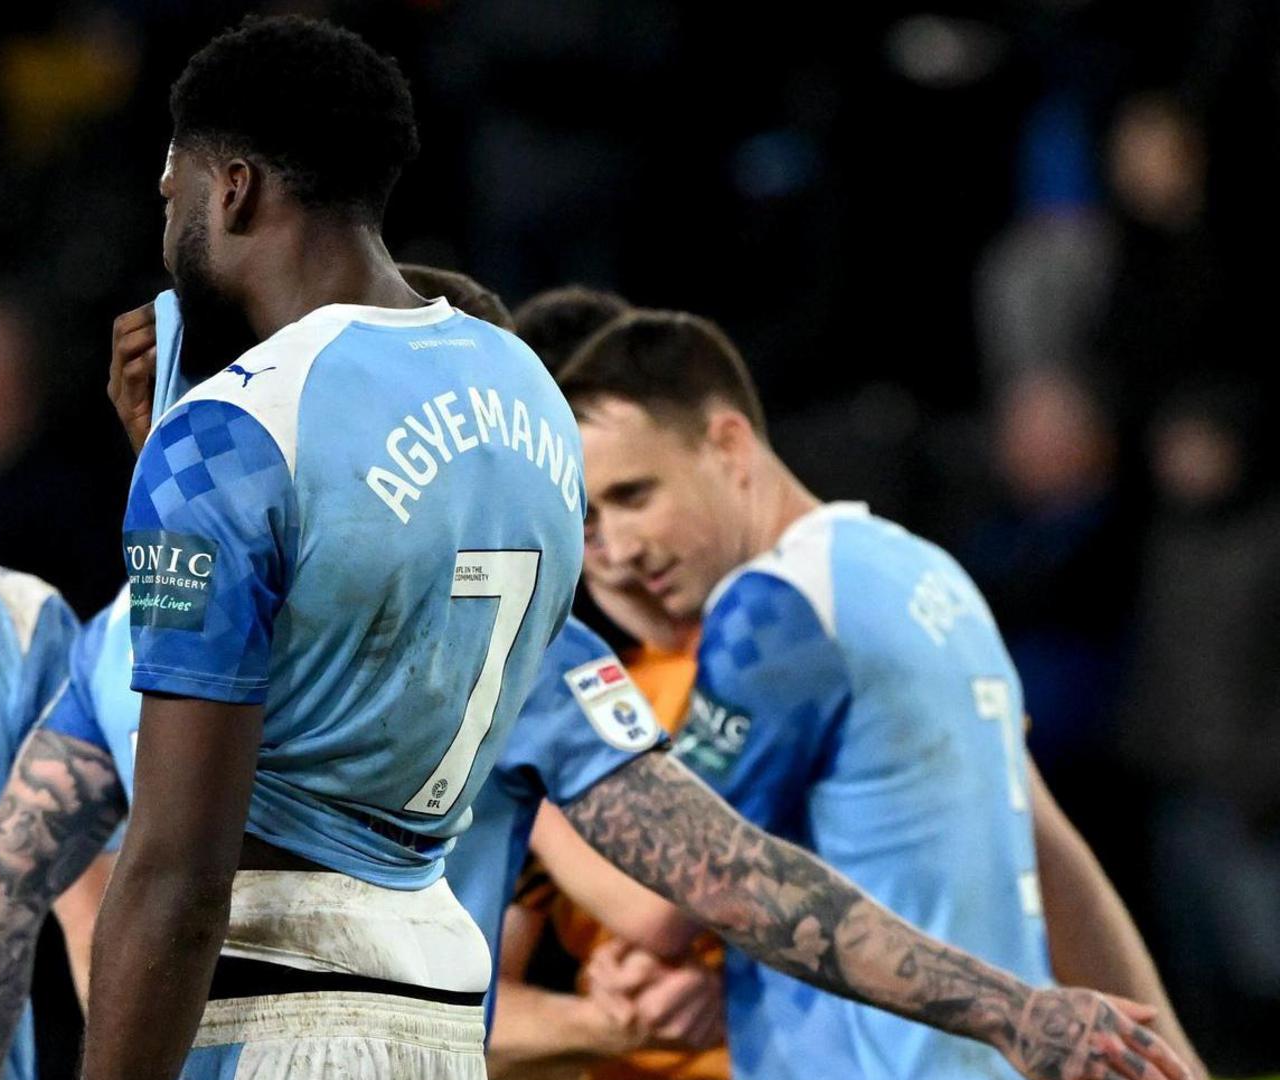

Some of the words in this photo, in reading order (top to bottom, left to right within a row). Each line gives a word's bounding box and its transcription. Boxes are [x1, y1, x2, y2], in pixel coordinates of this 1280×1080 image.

[155, 575, 207, 590] SURGERY
[400, 549, 543, 816] 7
[427, 799, 441, 809] EFL
